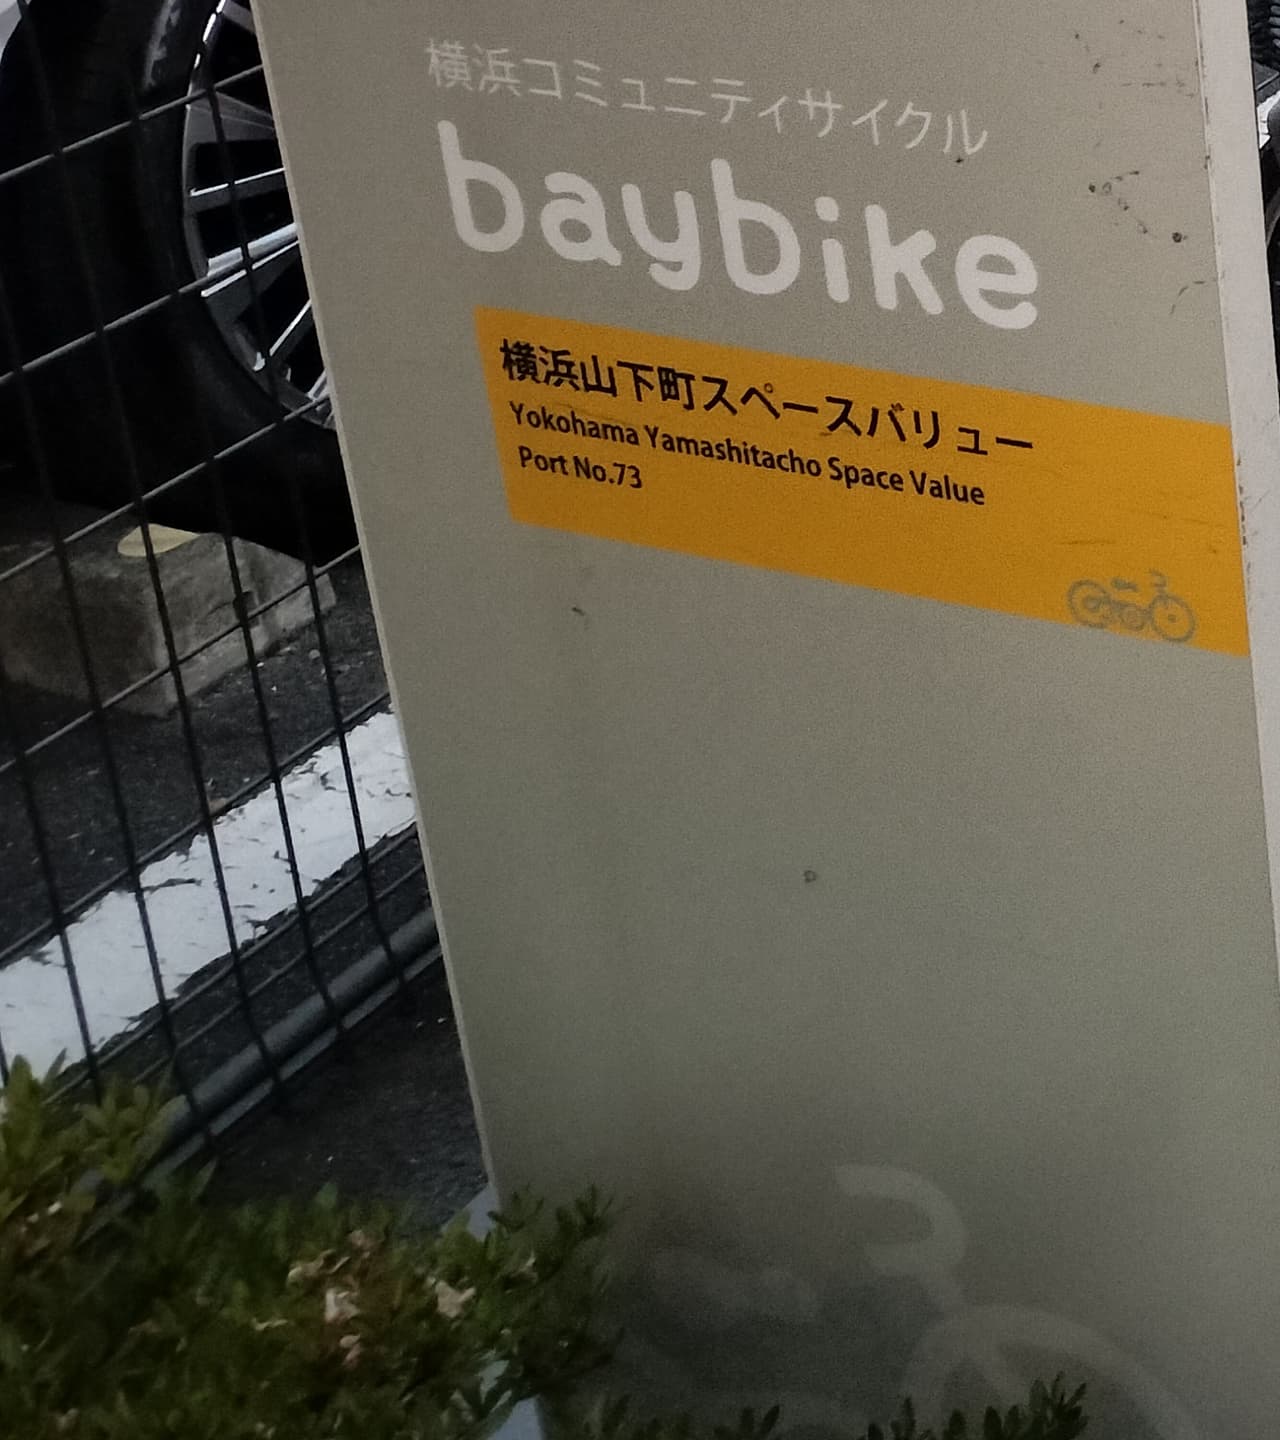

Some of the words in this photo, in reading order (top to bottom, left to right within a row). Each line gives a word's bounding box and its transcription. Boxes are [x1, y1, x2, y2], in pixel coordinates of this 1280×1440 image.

[425, 38, 988, 156] 横浜コミュニティサイクル
[437, 119, 1039, 330] baybike
[499, 338, 1034, 456] 横浜山下町スペースバリュー
[509, 400, 640, 446] Yokohama
[644, 424, 822, 477] Yamashitacho
[828, 456, 905, 492] Space
[909, 470, 986, 506] Value
[518, 445, 568, 476] Port
[573, 456, 642, 489] No.73
